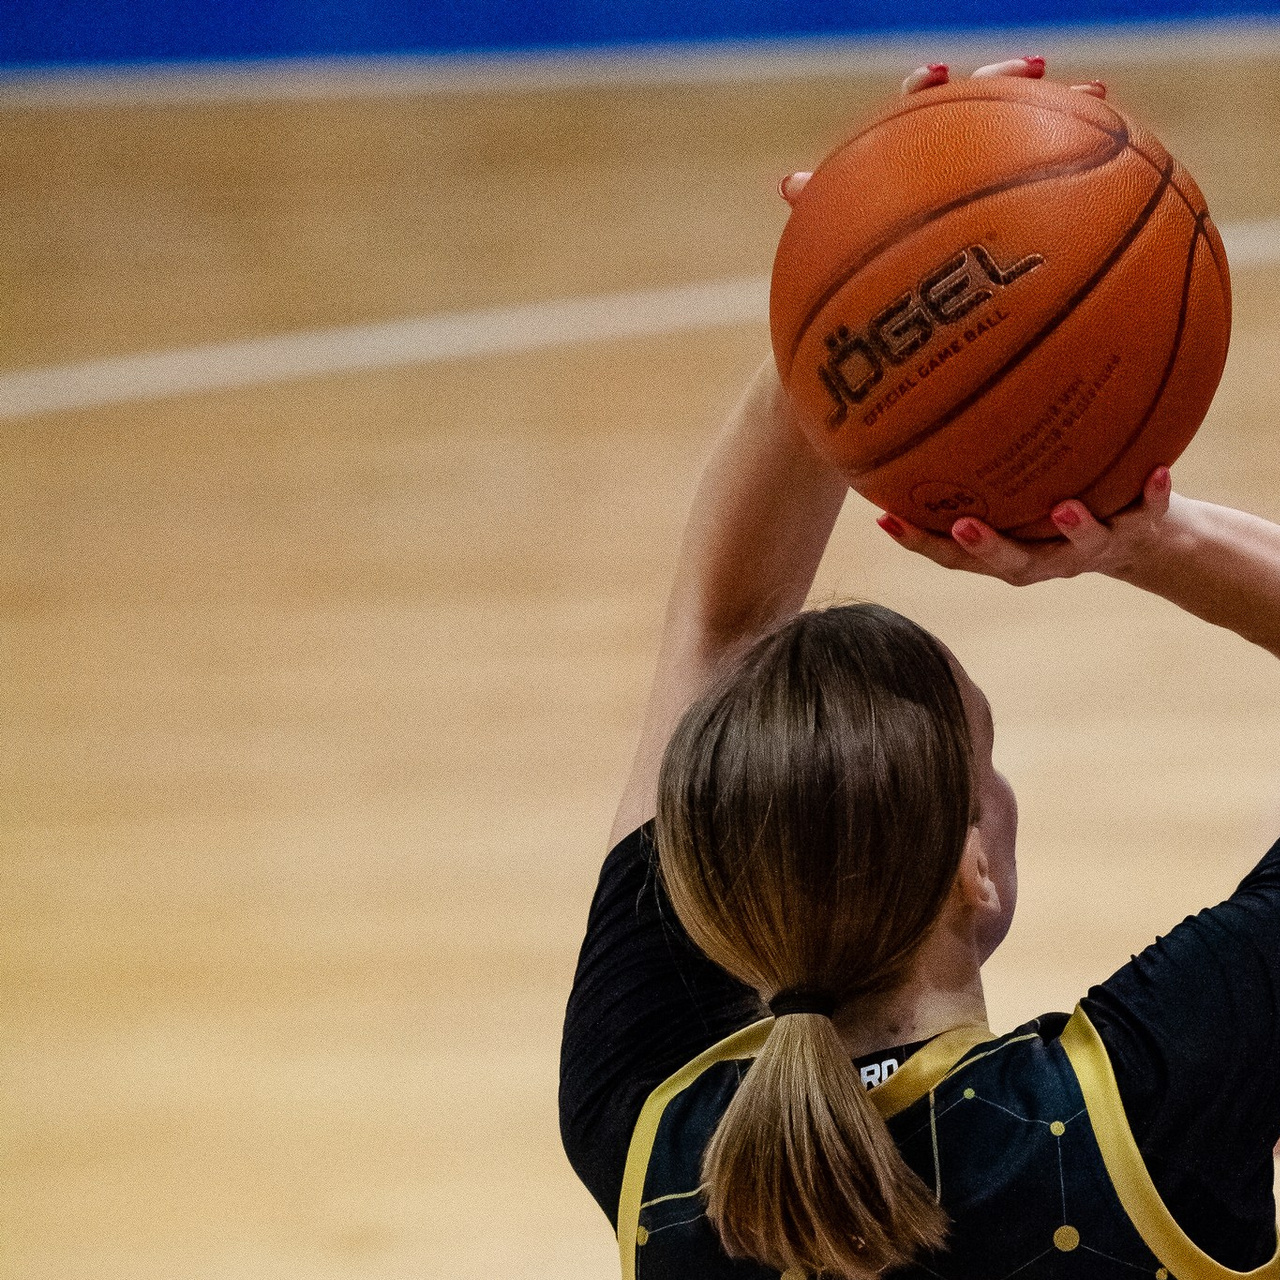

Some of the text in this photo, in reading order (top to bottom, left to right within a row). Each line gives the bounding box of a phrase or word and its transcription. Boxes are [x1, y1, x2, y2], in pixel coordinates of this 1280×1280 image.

[818, 243, 1046, 430] JÖGEL
[864, 309, 1011, 426] OFFICIAL GAME BALL
